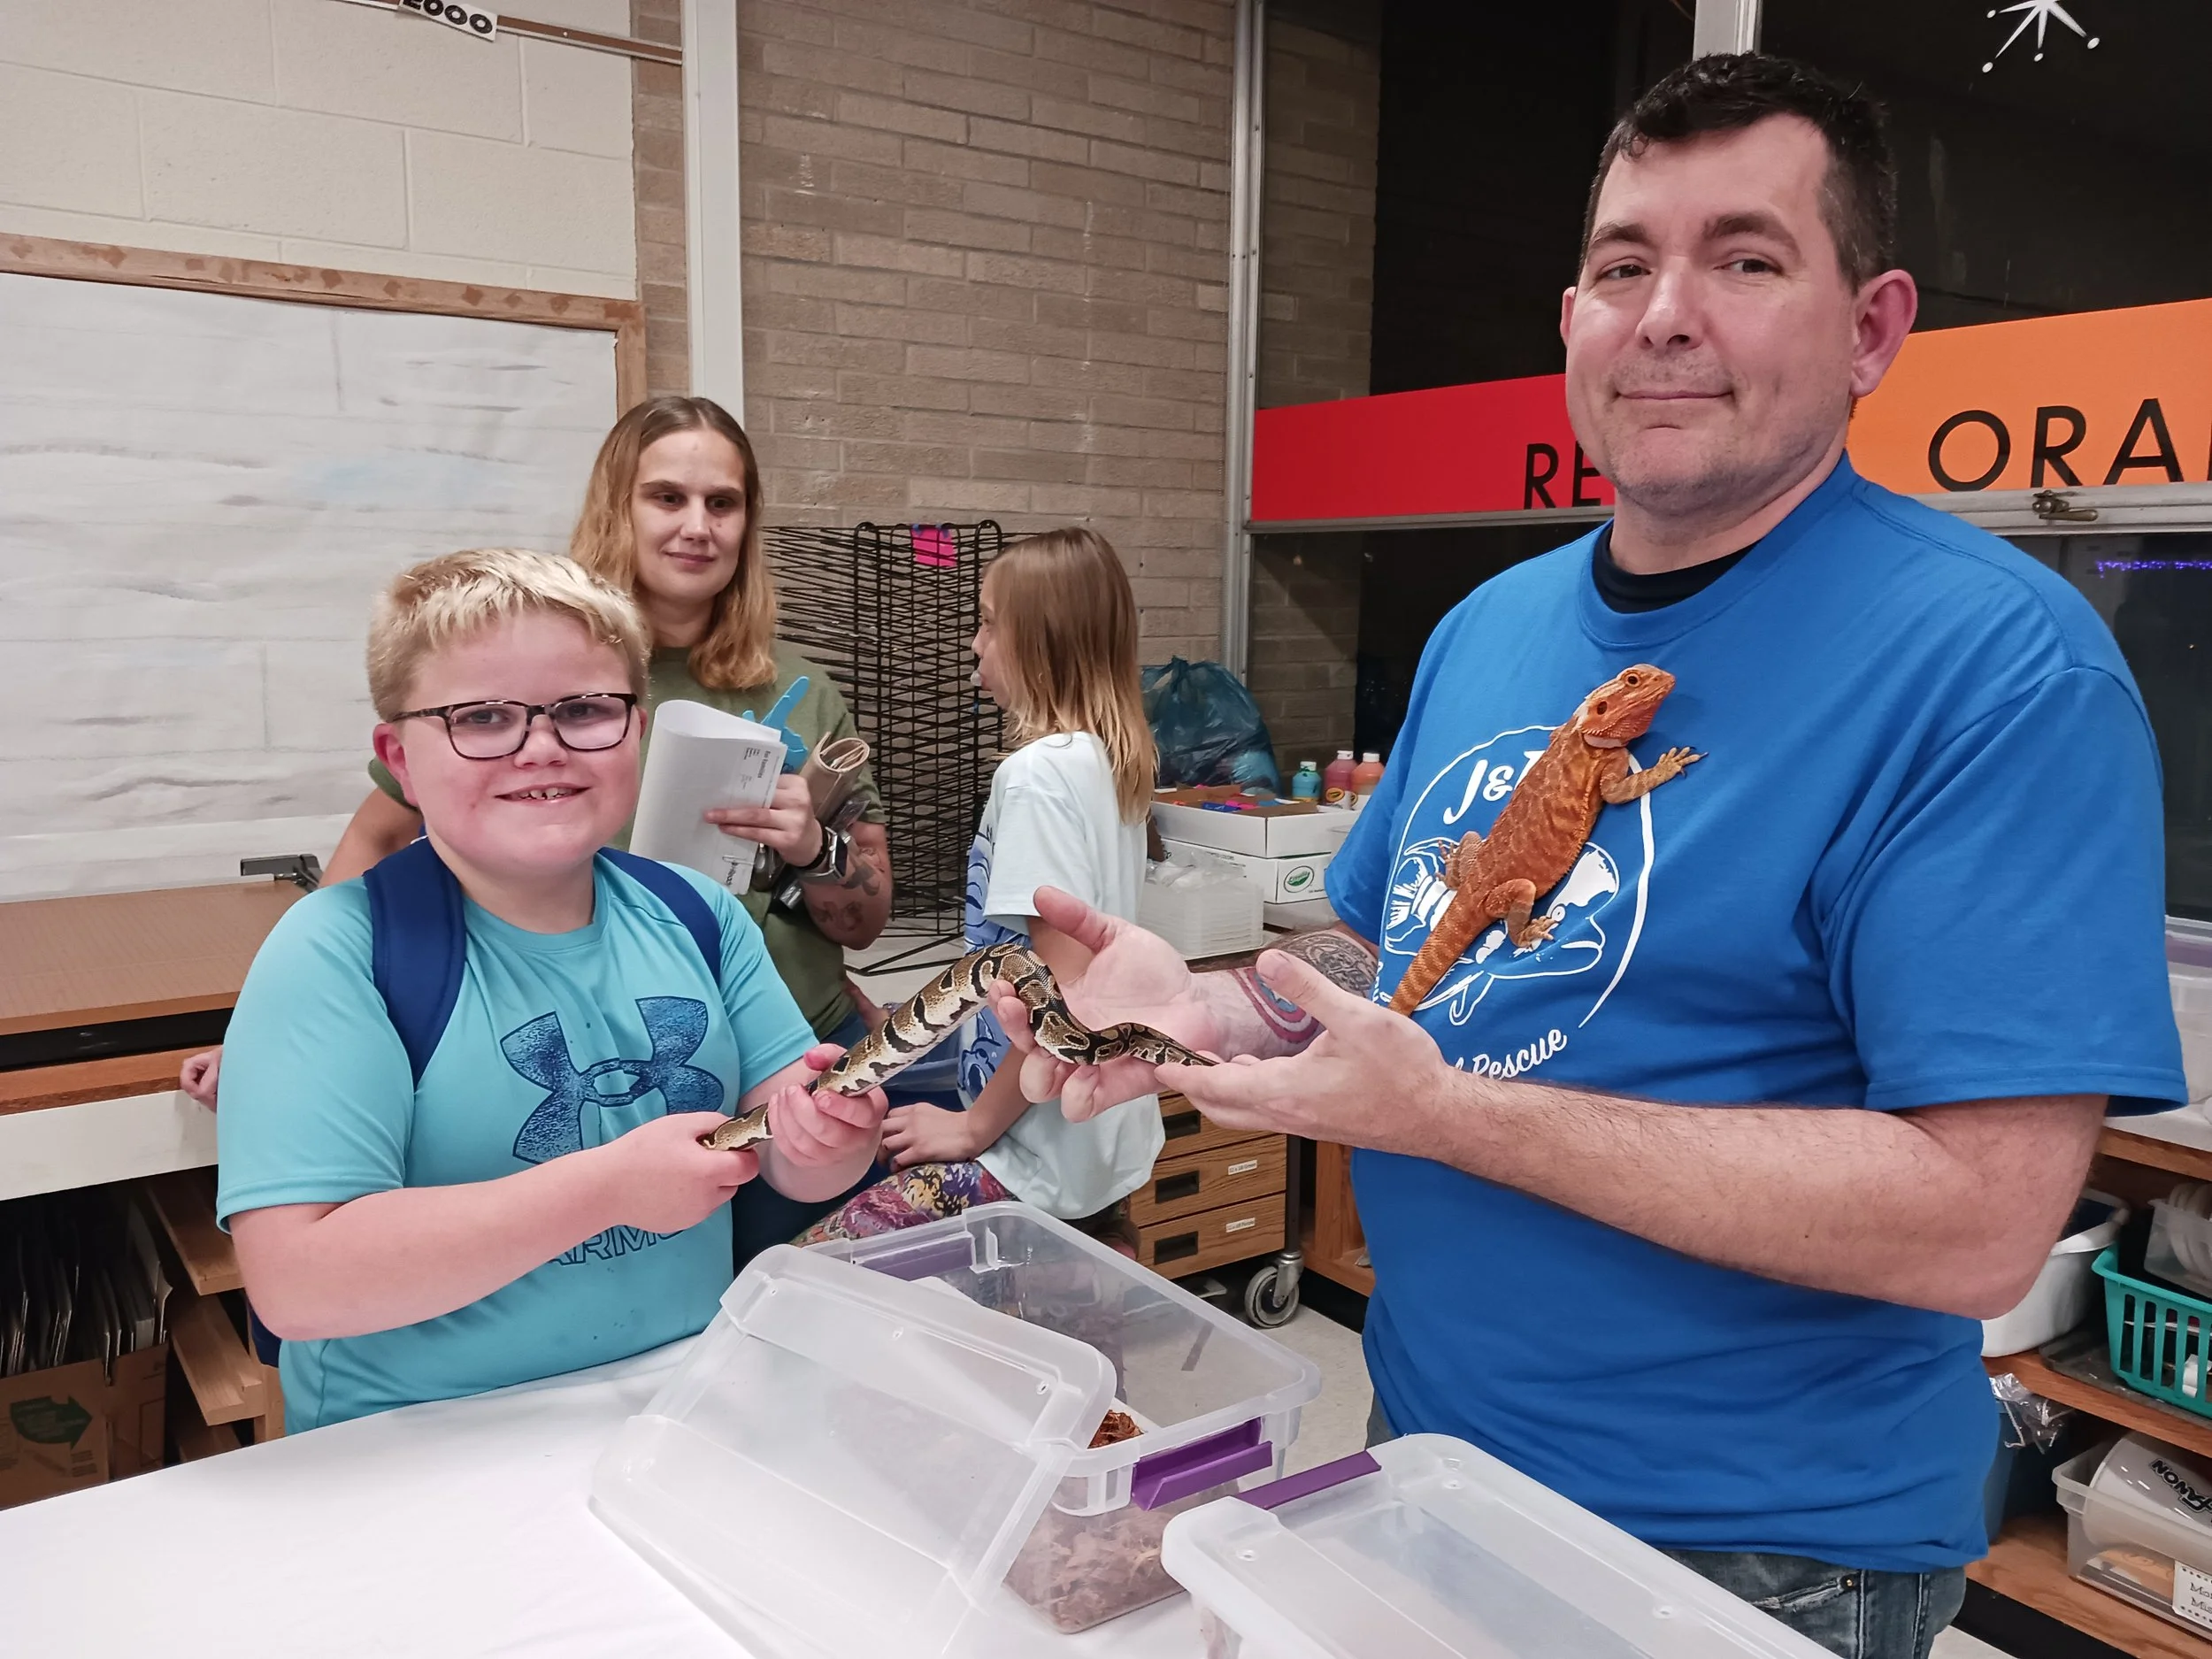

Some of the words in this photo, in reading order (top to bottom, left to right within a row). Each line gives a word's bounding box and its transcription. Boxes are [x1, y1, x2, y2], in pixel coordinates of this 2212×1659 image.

[1928, 398, 2212, 492] ORA
[1472, 1029, 1567, 1079] Rescue
[547, 1225, 684, 1265] RM
